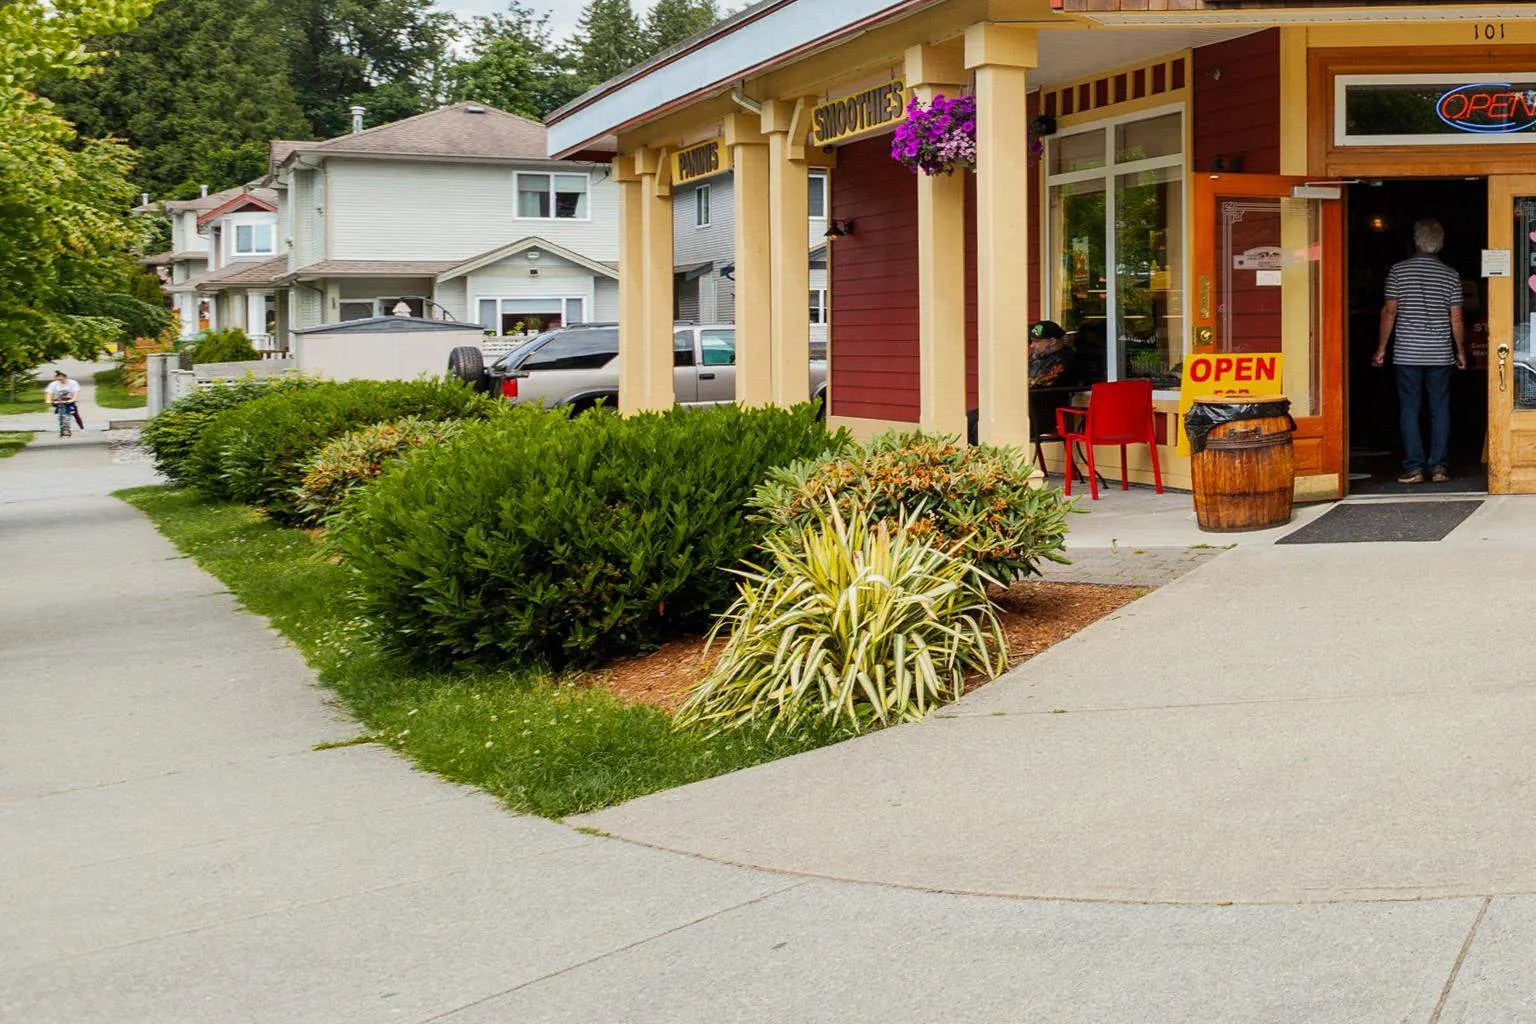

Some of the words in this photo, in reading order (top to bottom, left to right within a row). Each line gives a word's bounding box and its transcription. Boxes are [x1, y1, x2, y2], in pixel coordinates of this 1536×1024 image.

[1474, 23, 1505, 41] 101
[814, 81, 903, 141] SMOOTHIES
[1189, 357, 1276, 383] OPEN
